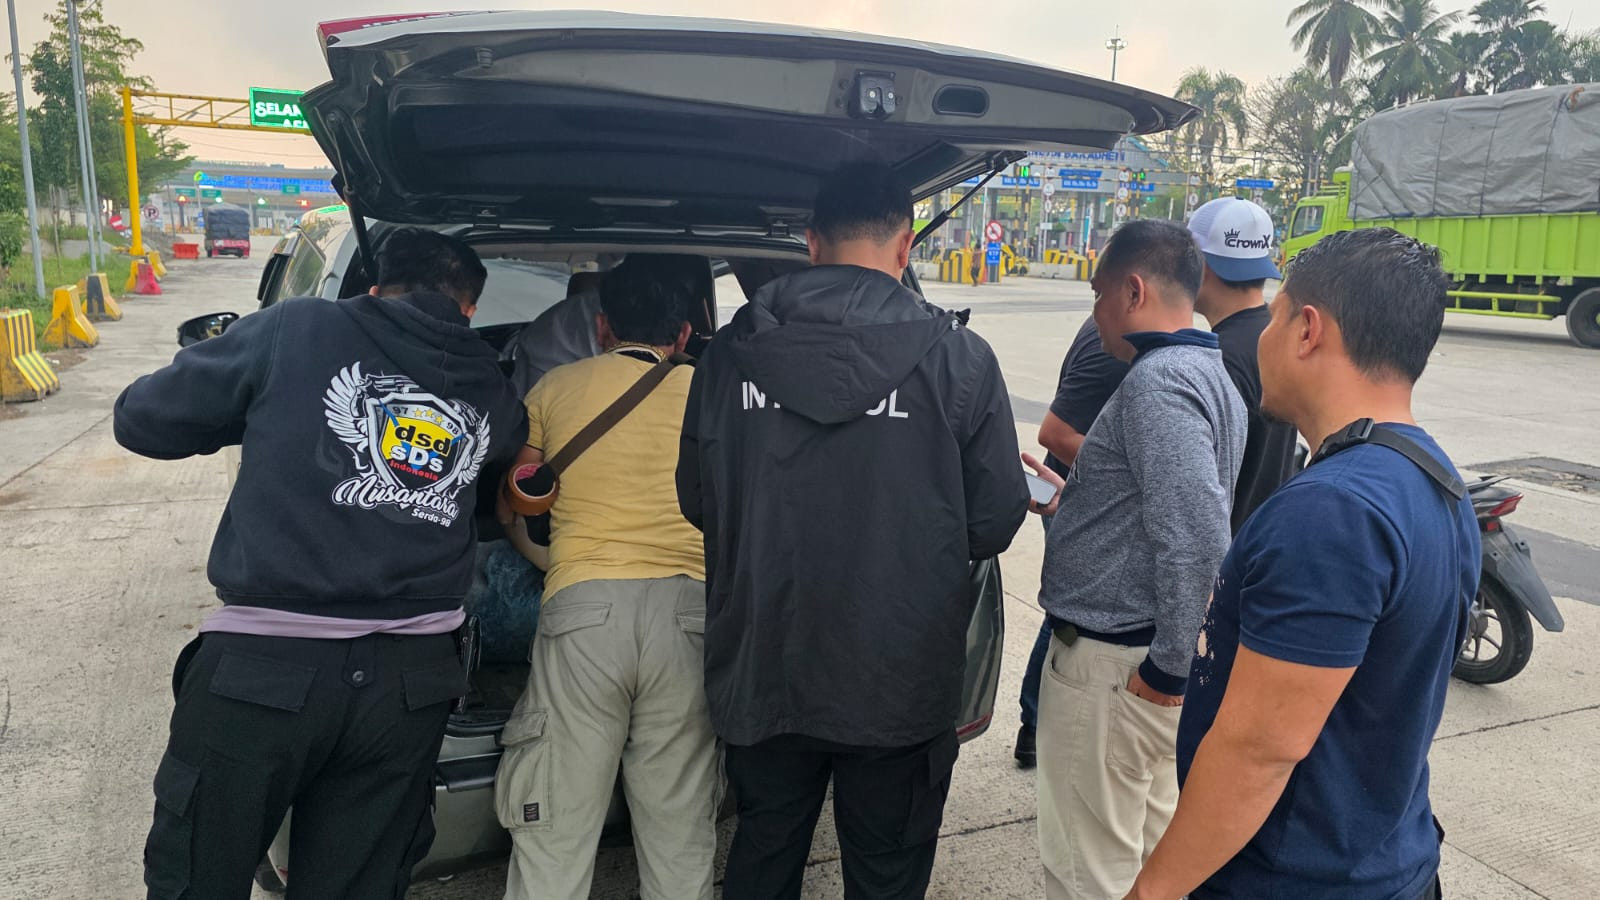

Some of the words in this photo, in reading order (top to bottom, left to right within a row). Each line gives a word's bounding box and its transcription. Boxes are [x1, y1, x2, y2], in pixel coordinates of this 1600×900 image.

[392, 406, 409, 415] 97
[395, 425, 451, 457] dsd
[333, 474, 459, 519] Nusantara
